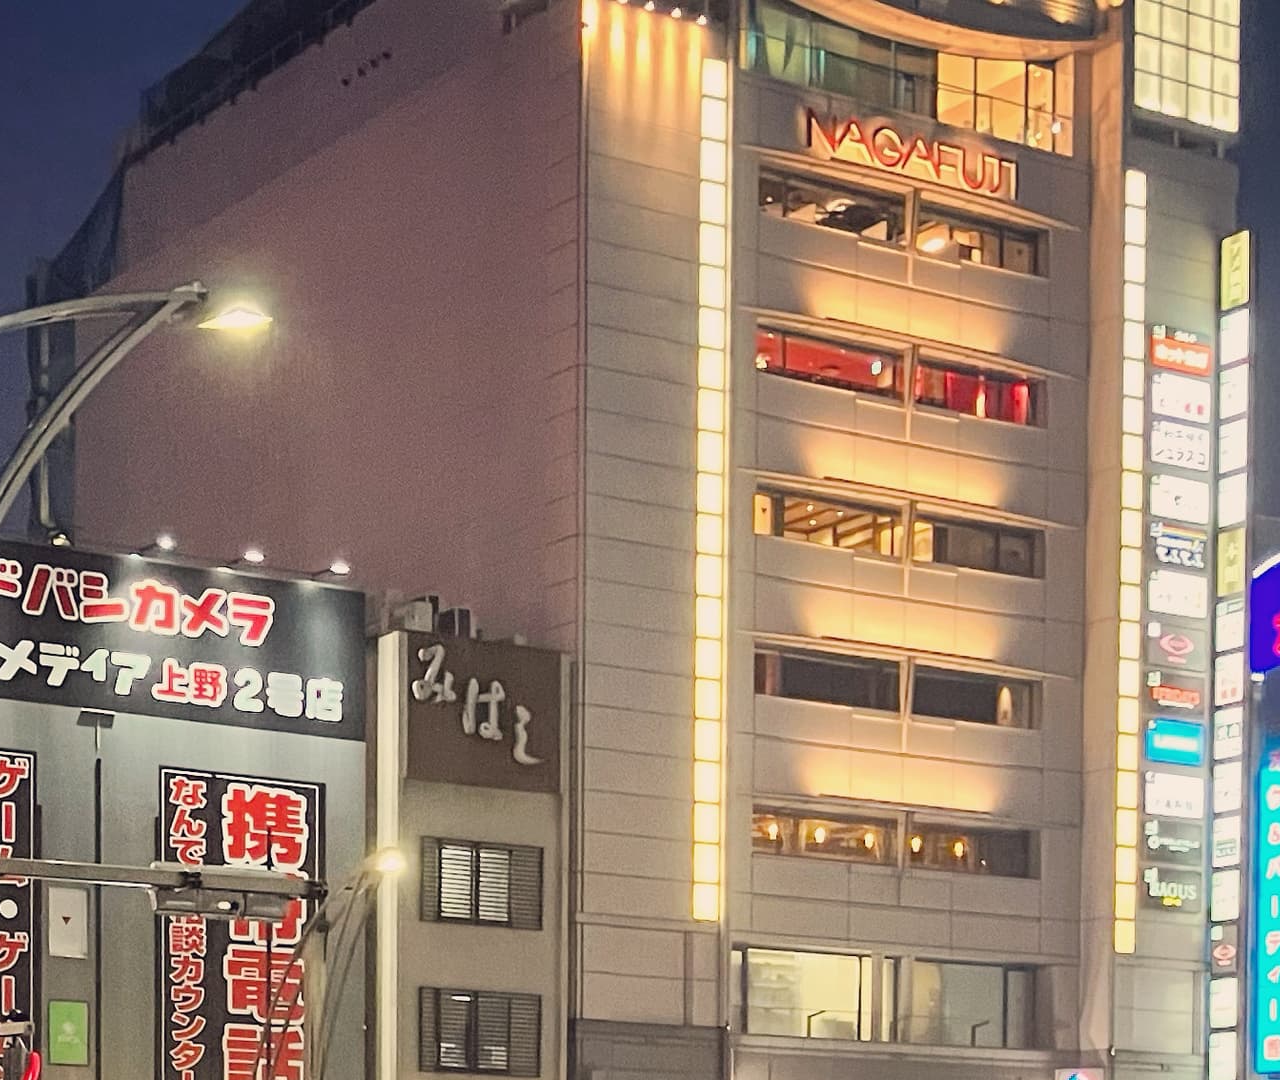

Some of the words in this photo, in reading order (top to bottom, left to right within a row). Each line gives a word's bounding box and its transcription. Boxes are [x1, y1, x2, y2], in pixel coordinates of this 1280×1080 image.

[805, 106, 1019, 201] NAGAFUJI
[411, 642, 546, 766] みはし
